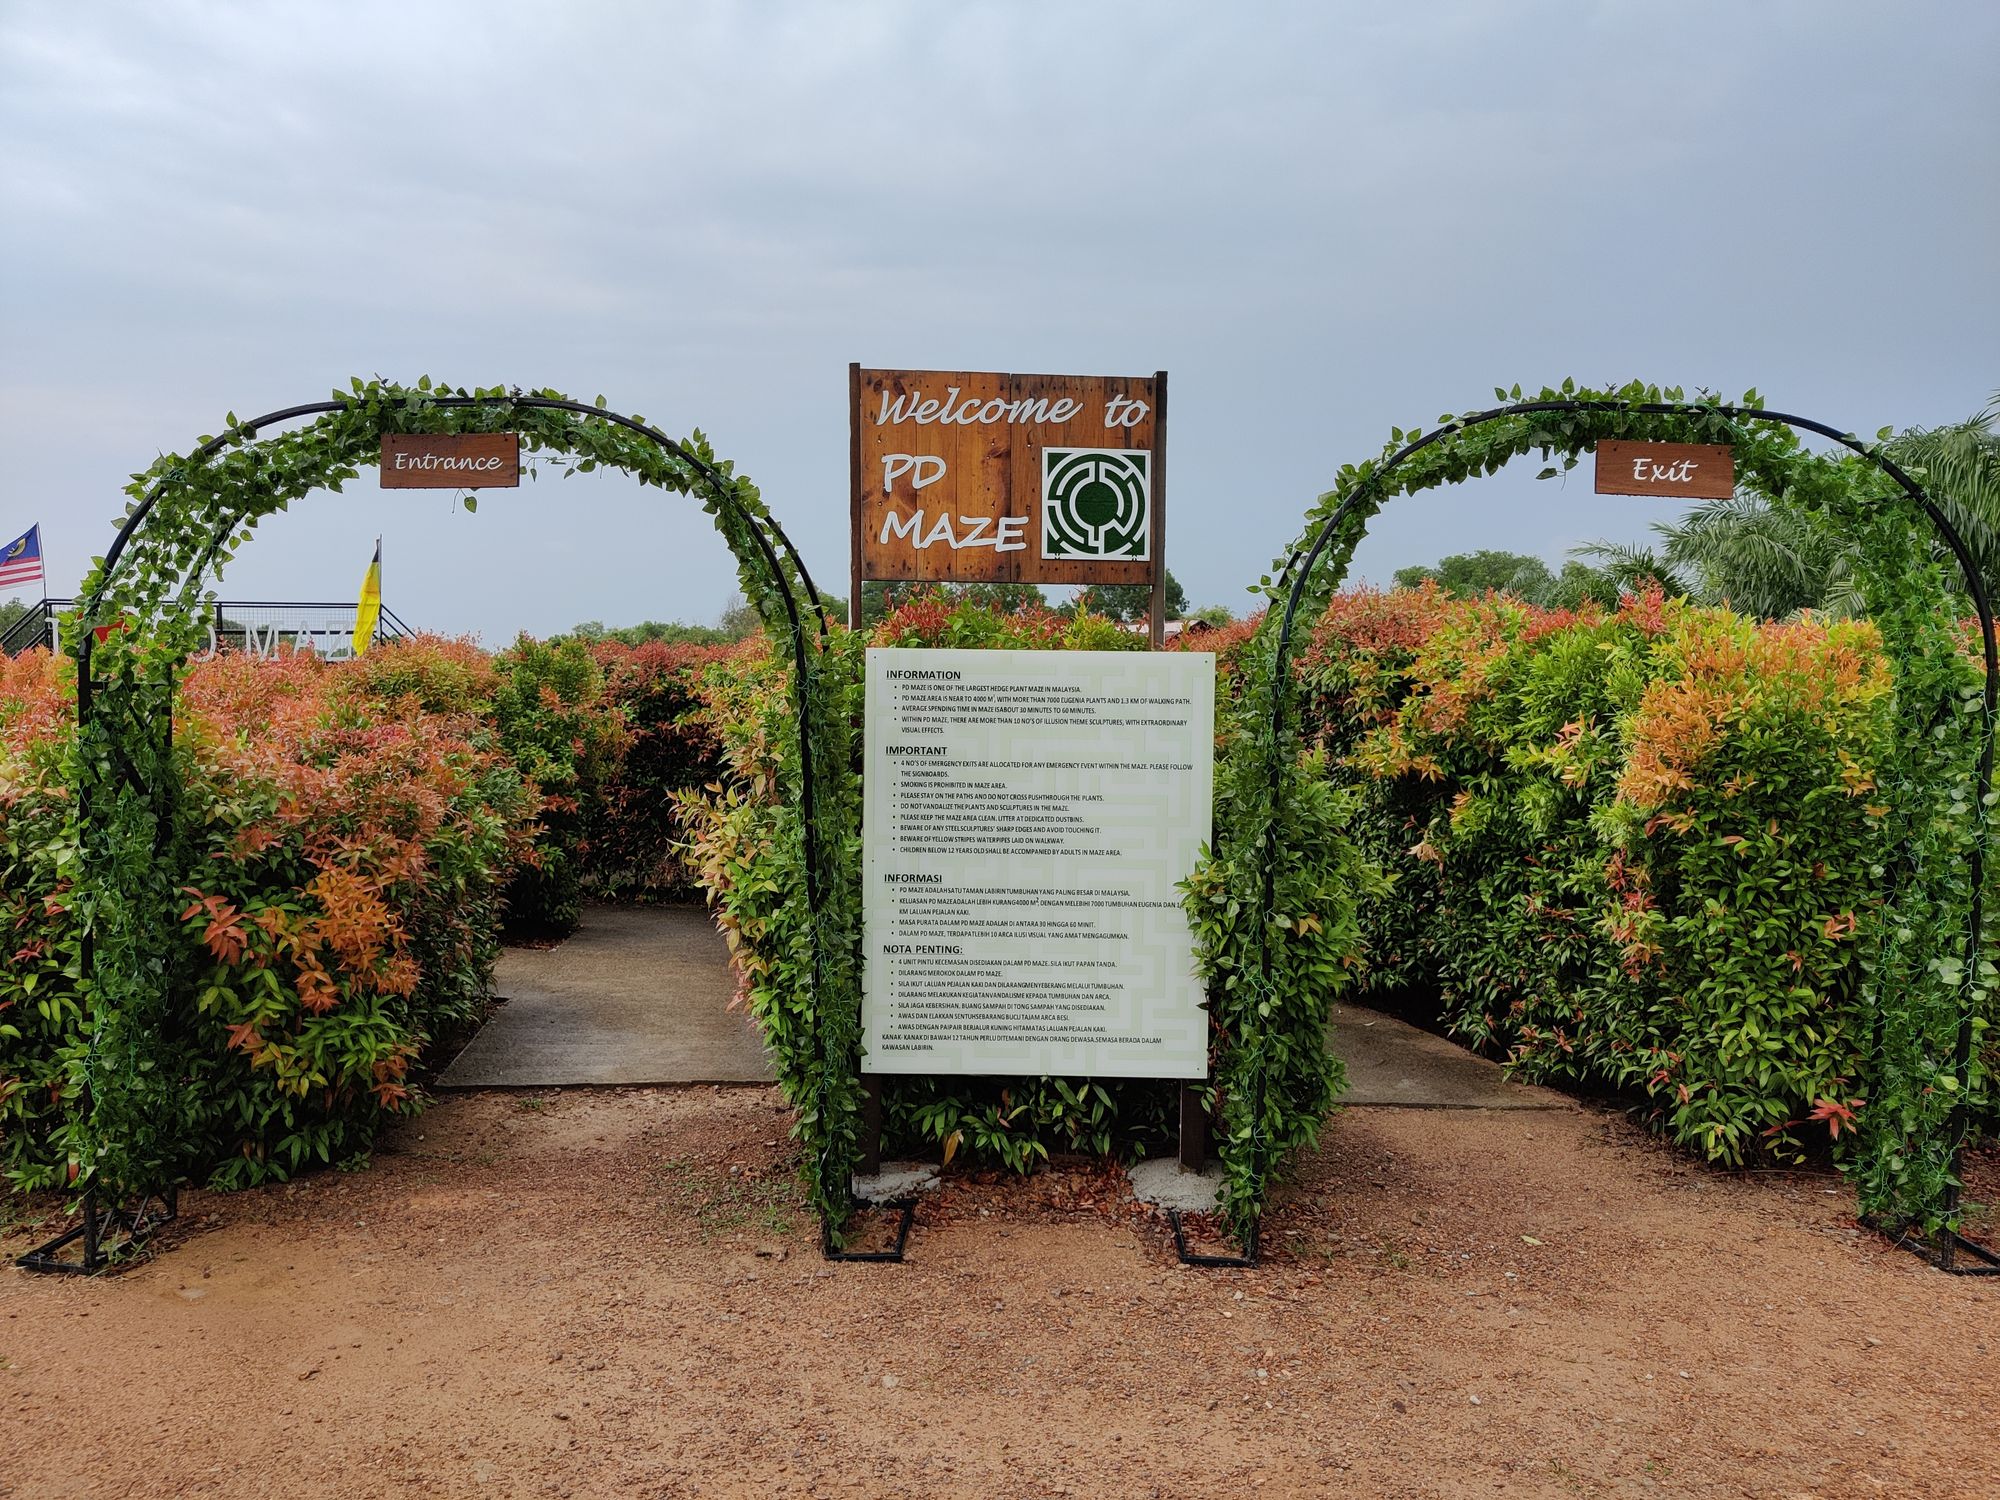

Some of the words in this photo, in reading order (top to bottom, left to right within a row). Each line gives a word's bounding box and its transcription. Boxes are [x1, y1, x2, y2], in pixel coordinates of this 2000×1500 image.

[876, 387, 1083, 426] Welcome
[1104, 393, 1150, 428] to
[395, 452, 503, 470] Entrance
[881, 453, 947, 493] PD
[1633, 458, 1699, 483] Exit
[879, 509, 1029, 553] MAZE
[886, 670, 961, 680] INFORMATION
[885, 746, 947, 756] IMPORTANT
[884, 874, 942, 883] INFORMASI
[883, 945, 911, 954] NOTA
[916, 945, 963, 954] PENTING:
